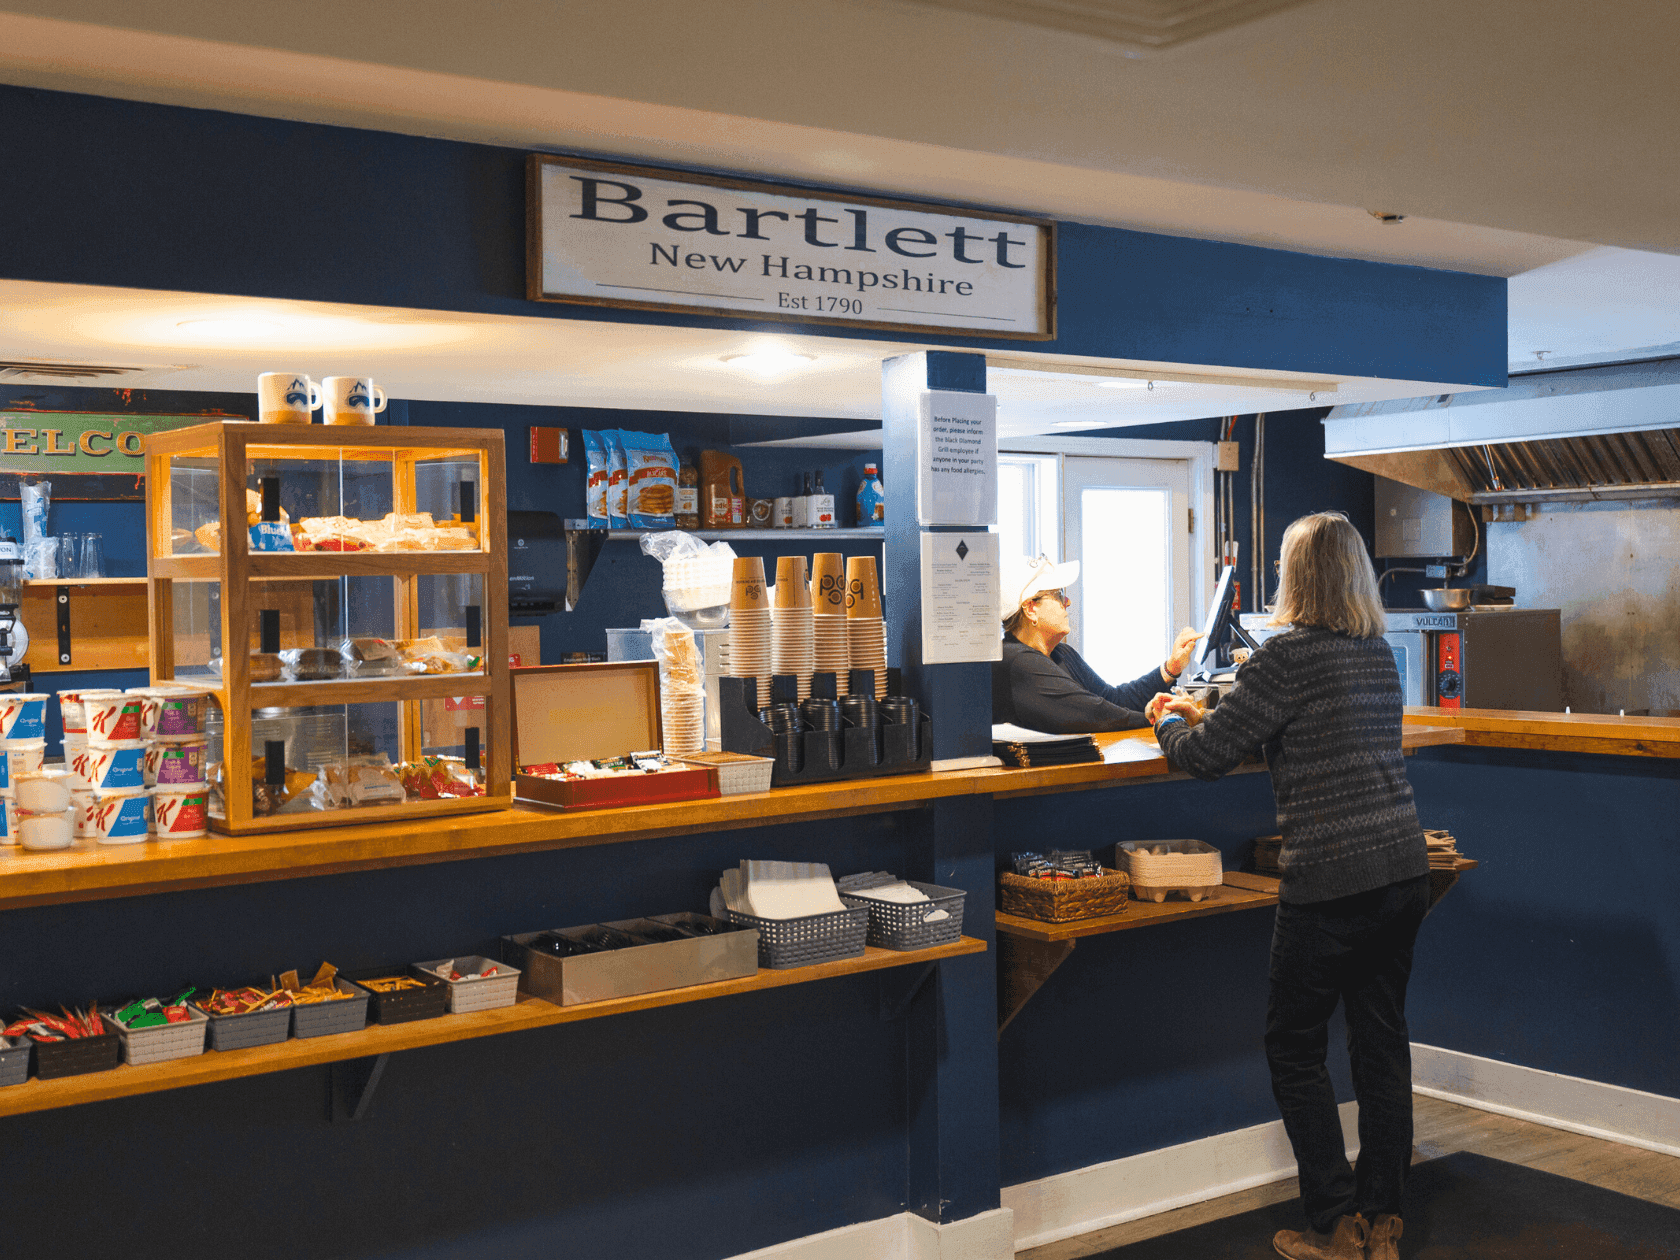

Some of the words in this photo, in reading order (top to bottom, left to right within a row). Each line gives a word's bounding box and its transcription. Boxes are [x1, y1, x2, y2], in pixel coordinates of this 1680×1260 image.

[568, 175, 1027, 269] Bartlett
[649, 242, 747, 272] New
[761, 254, 974, 297] Hampshire
[777, 292, 809, 311] Est
[815, 295, 863, 315] 1790
[1416, 615, 1456, 628] VULCAN
[93, 706, 116, 734] K
[157, 799, 177, 827] K
